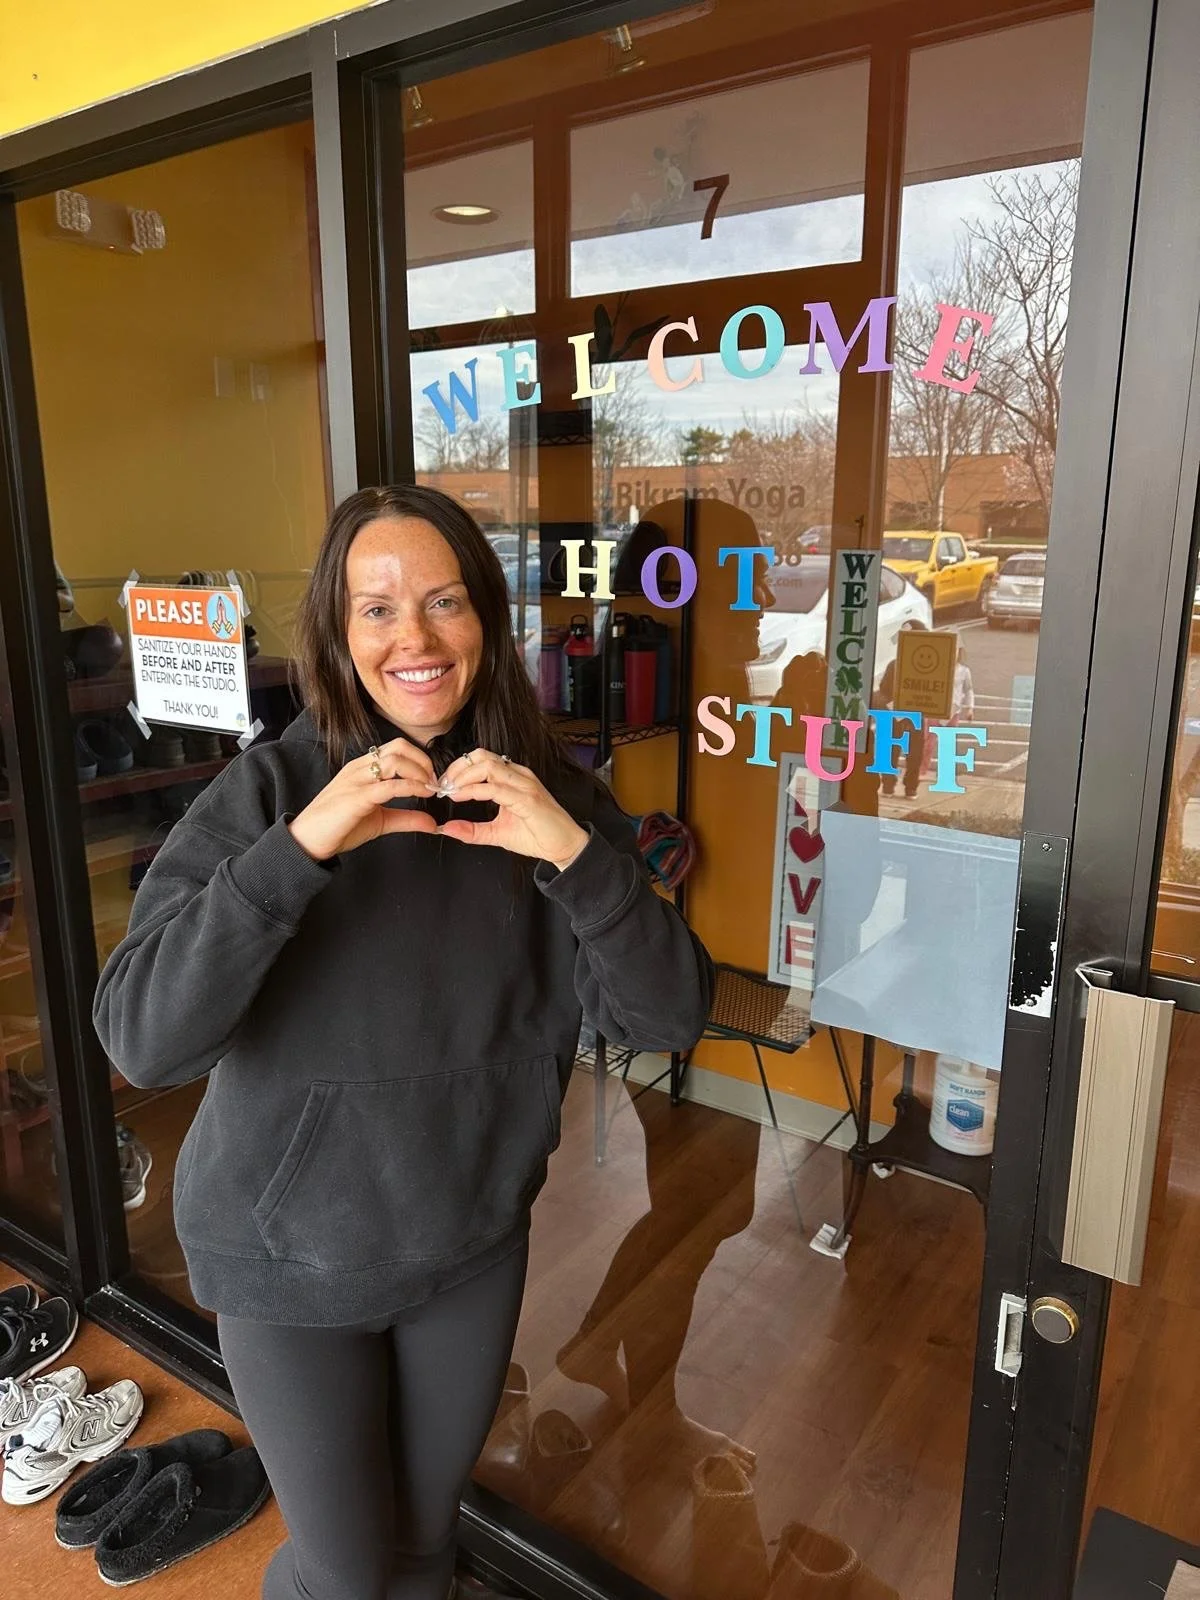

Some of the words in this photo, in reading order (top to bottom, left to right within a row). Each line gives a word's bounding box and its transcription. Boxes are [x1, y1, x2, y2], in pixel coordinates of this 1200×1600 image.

[693, 174, 730, 240] 7
[422, 296, 995, 435] WELCOME
[726, 478, 806, 517] Yoga
[560, 539, 776, 612] HOT
[135, 599, 204, 625] PLEASE
[138, 638, 174, 654] SANITIZE
[175, 642, 202, 656] YOUR
[203, 644, 237, 660] HANDS
[142, 655, 178, 670] BEFORE
[181, 659, 202, 672] AND
[204, 663, 236, 676] AFTER
[141, 670, 182, 686] ENTERING
[184, 674, 201, 688] THE
[202, 676, 240, 692] STUDIO.
[163, 699, 193, 715] THANK
[194, 703, 219, 719] YOU!
[697, 695, 988, 794] STUFF
[80, 1418, 101, 1442] N
